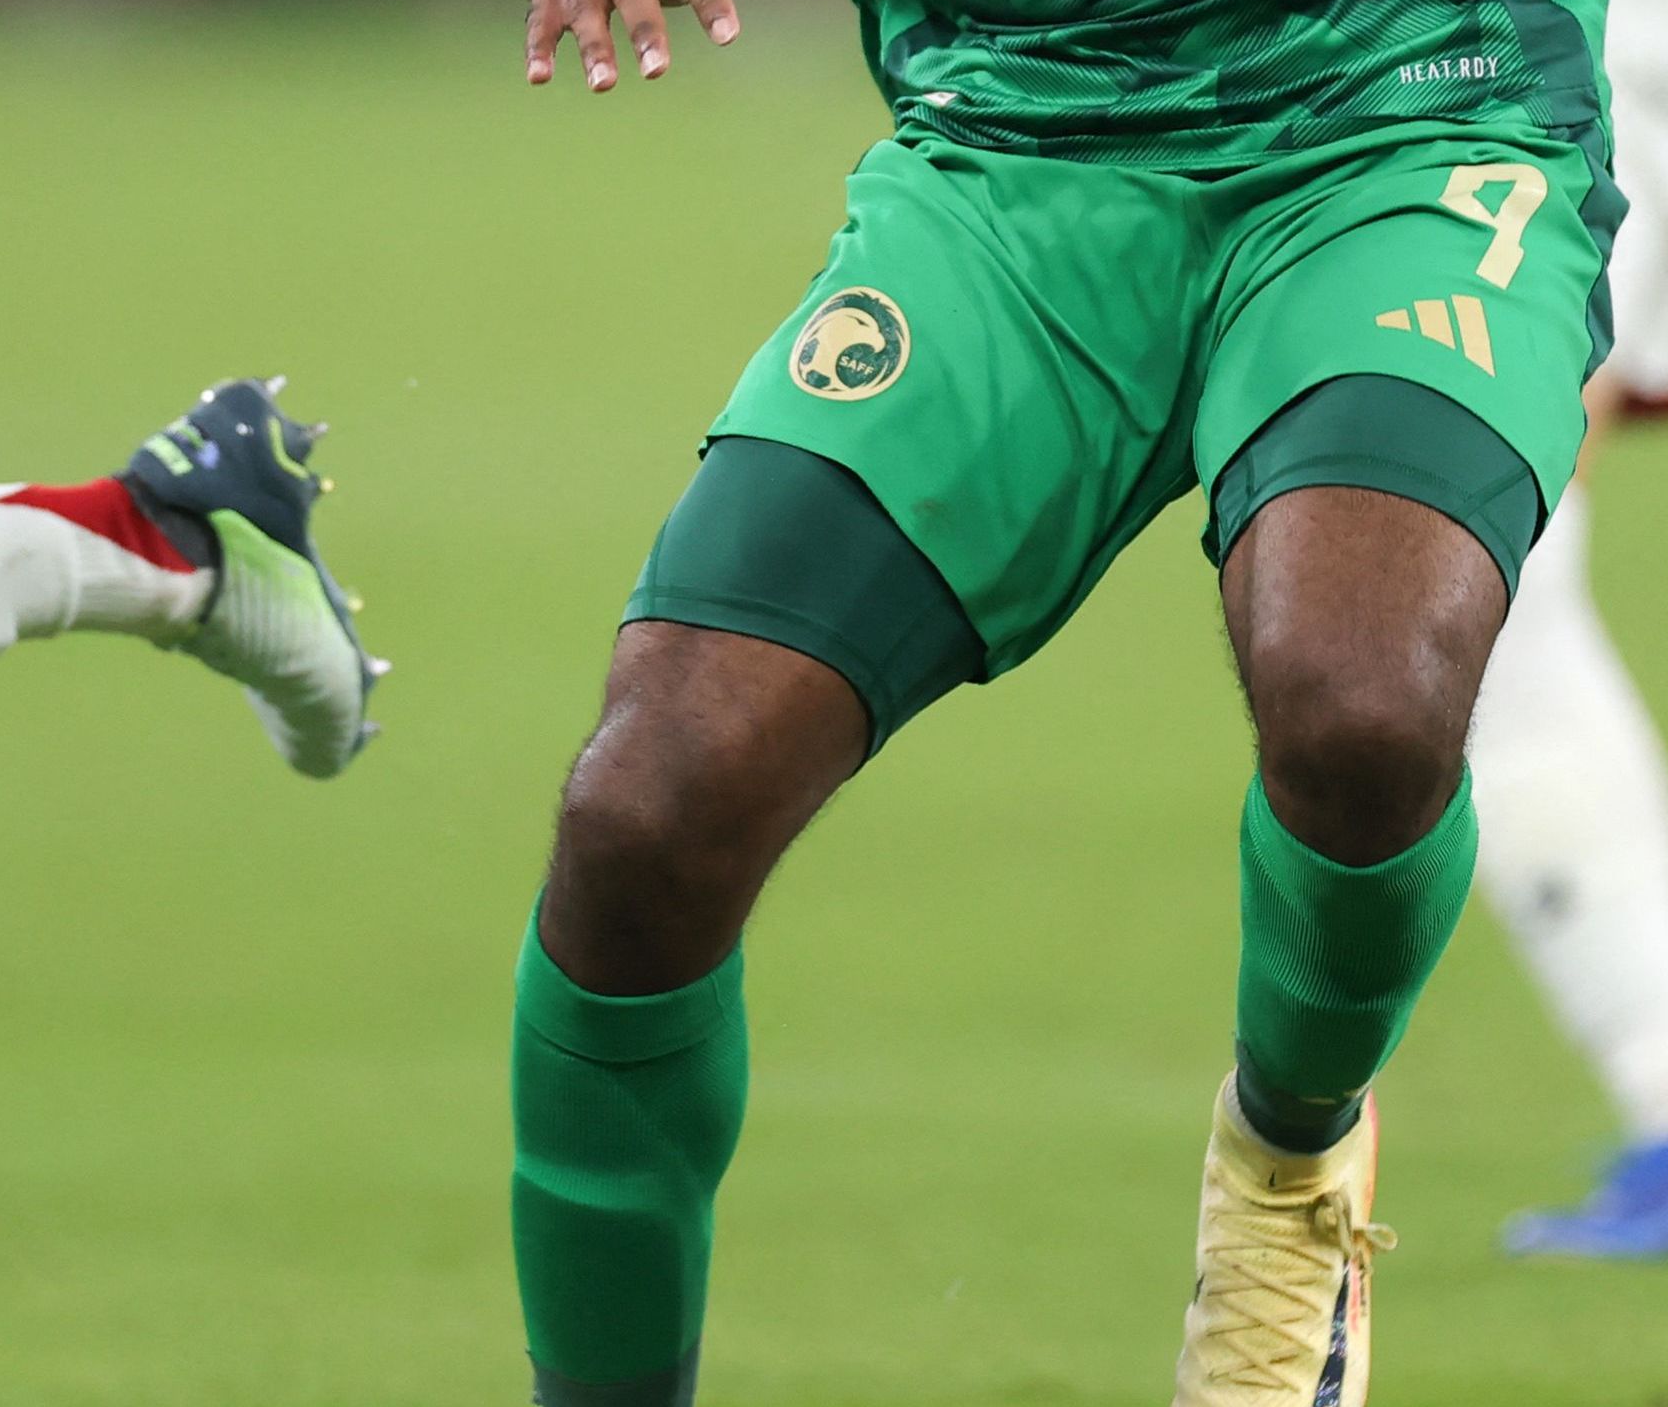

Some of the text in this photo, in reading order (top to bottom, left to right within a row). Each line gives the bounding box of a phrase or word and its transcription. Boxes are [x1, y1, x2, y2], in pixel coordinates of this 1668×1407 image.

[1399, 56, 1499, 85] HEAT.RDY
[1437, 163, 1548, 290] 9
[839, 355, 875, 375] SAFF
